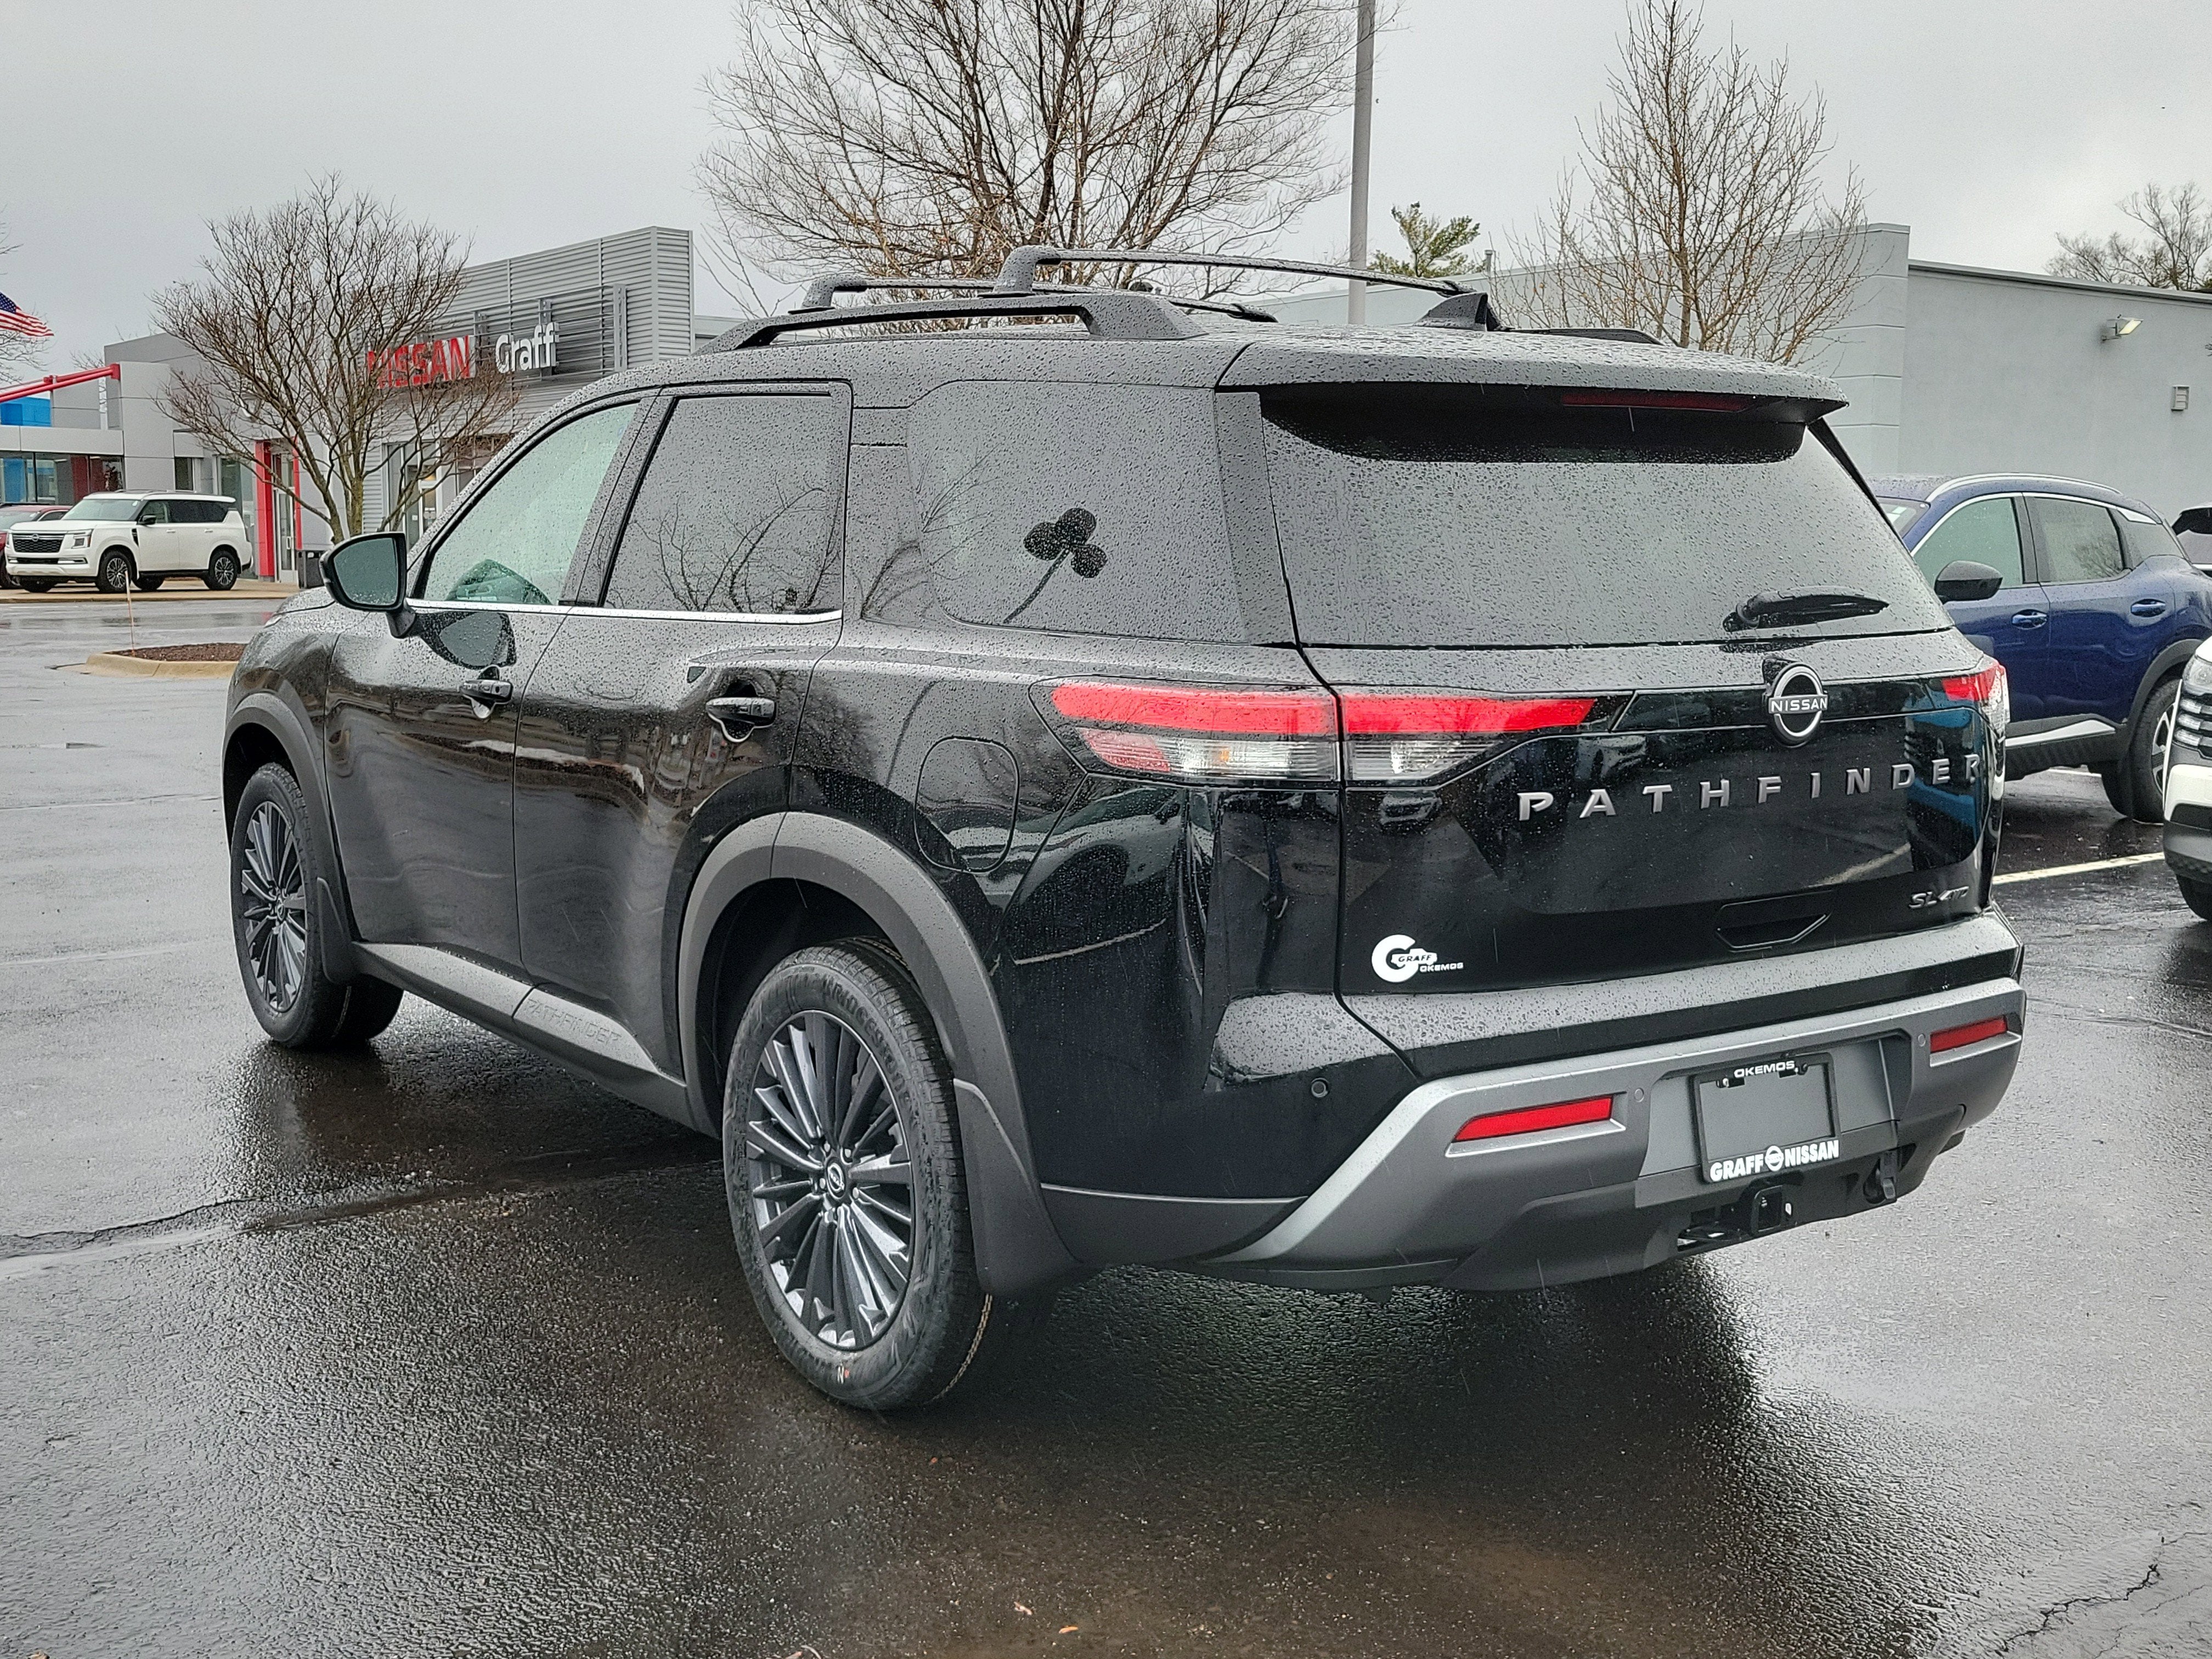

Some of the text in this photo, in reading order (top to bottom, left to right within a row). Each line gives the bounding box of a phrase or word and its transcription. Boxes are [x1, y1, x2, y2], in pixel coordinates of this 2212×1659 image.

[367, 323, 556, 390] NISSAN Graff
[1771, 697, 1827, 713] NISSAN
[1517, 754, 1980, 821] PATHFINDER
[1909, 891, 1937, 909] SL
[1420, 962, 1464, 973] OKEMOS
[1734, 1060, 1795, 1078] OKEMOS
[1709, 1140, 1839, 1182] GRAFF NISSAN
